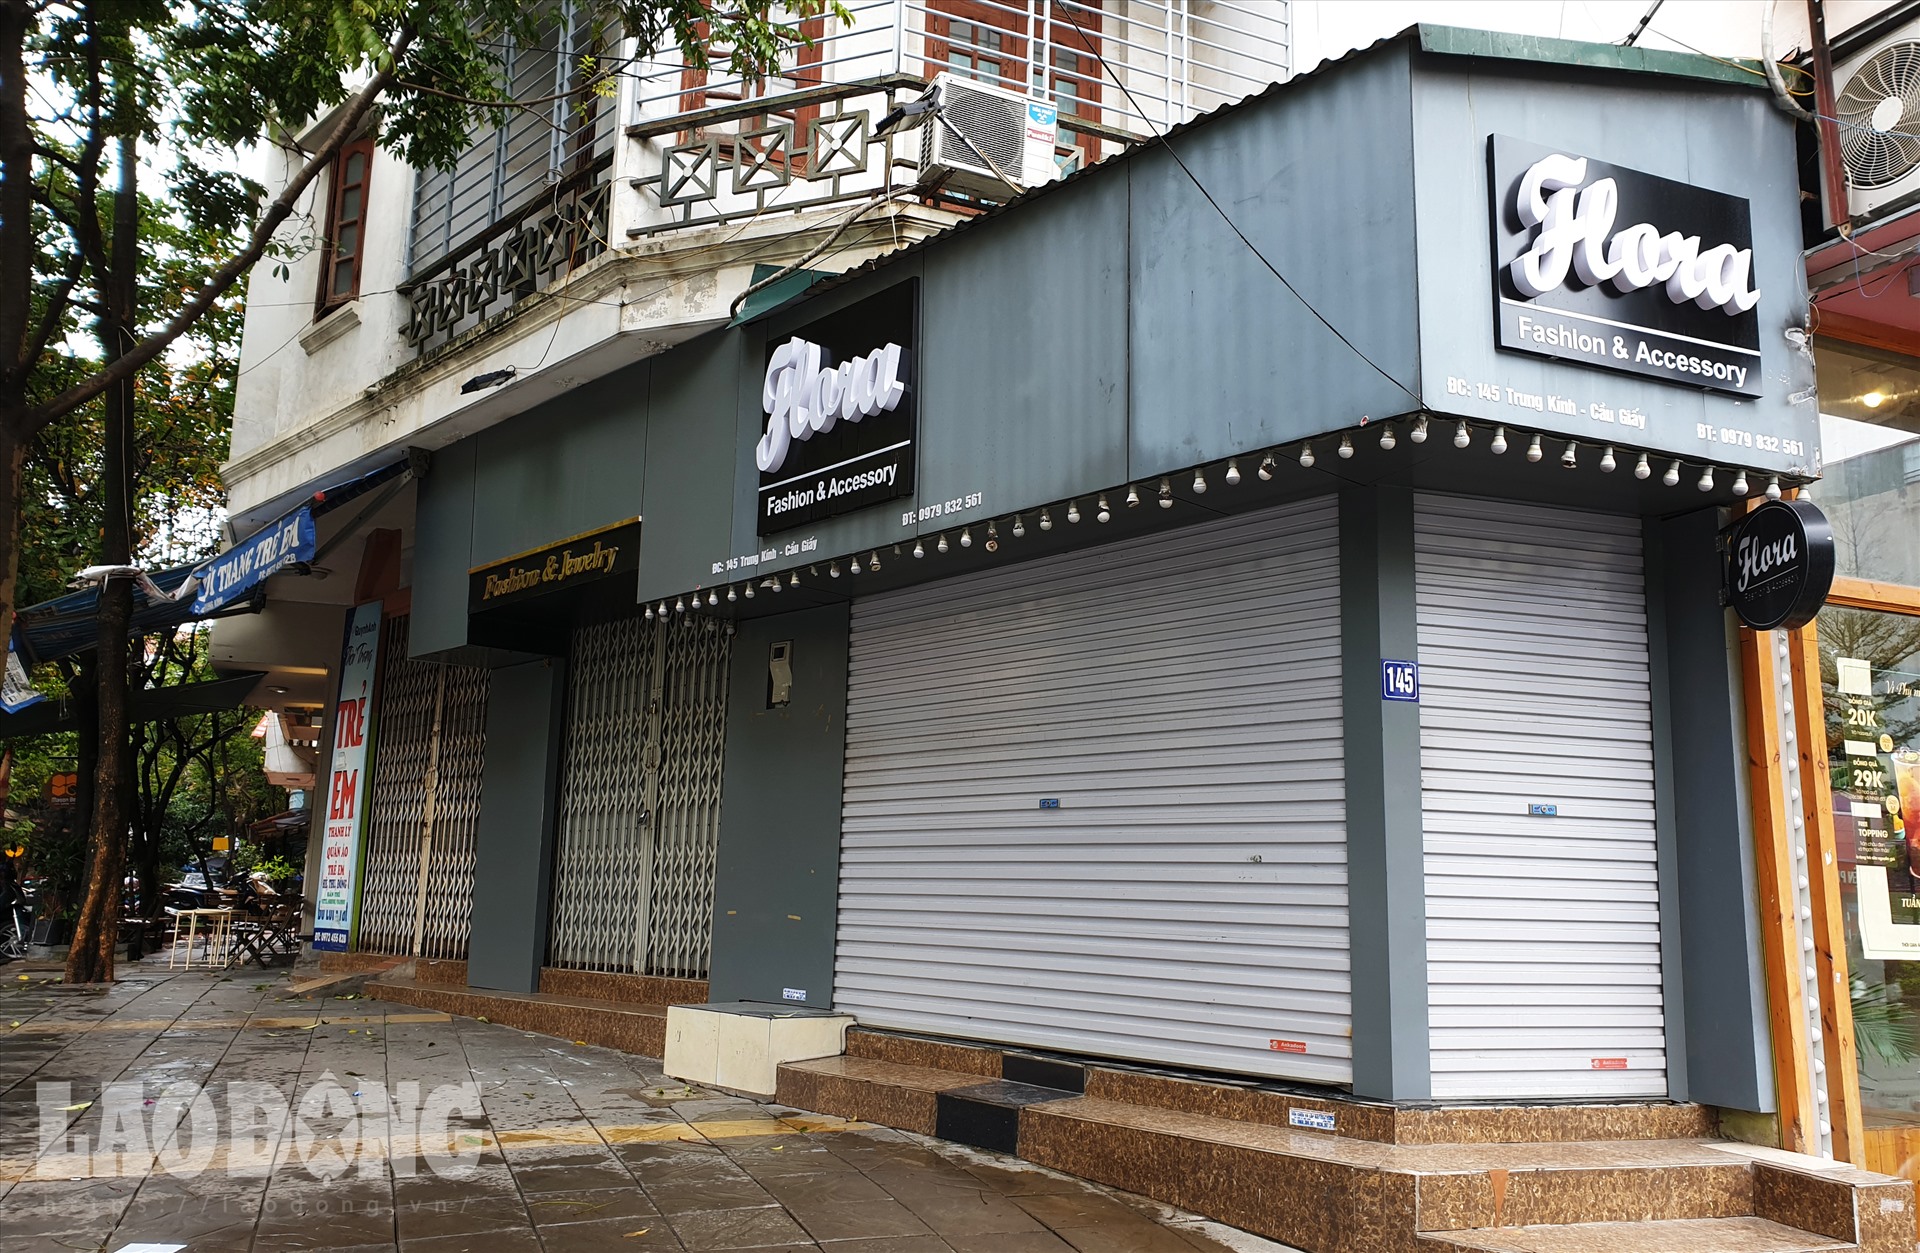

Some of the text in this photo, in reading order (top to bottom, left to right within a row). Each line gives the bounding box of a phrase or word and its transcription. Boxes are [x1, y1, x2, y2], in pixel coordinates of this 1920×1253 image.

[1510, 154, 1761, 316] Flora
[1612, 335, 1629, 359] &
[1635, 341, 1747, 388] Accessory
[756, 336, 905, 473] Flora
[1447, 376, 1472, 397] ĐC:
[1476, 382, 1500, 402] 145
[1505, 387, 1544, 412] Trung
[1547, 394, 1577, 416] Kính
[1618, 407, 1646, 430] Giấy
[1697, 422, 1804, 457] ĐT: 0979 832 561
[767, 463, 898, 517] Fashion & Accessory
[902, 491, 982, 526] ĐT: 0979 832 561
[217, 547, 255, 593] TRANG
[279, 516, 300, 556] EM
[482, 541, 619, 600] Fashion & Jewelry
[726, 557, 738, 571] 145
[740, 554, 759, 567] Trung
[761, 548, 777, 562] Kính
[801, 535, 818, 552] Giấy
[1737, 532, 1799, 592] Flora
[1386, 666, 1414, 694] 145
[337, 679, 367, 749] TRẺ
[1848, 708, 1877, 727] 20K
[330, 769, 358, 820] EM
[1853, 769, 1884, 788] 29K
[328, 826, 344, 838] THANH
[1858, 829, 1888, 838] TOPPING
